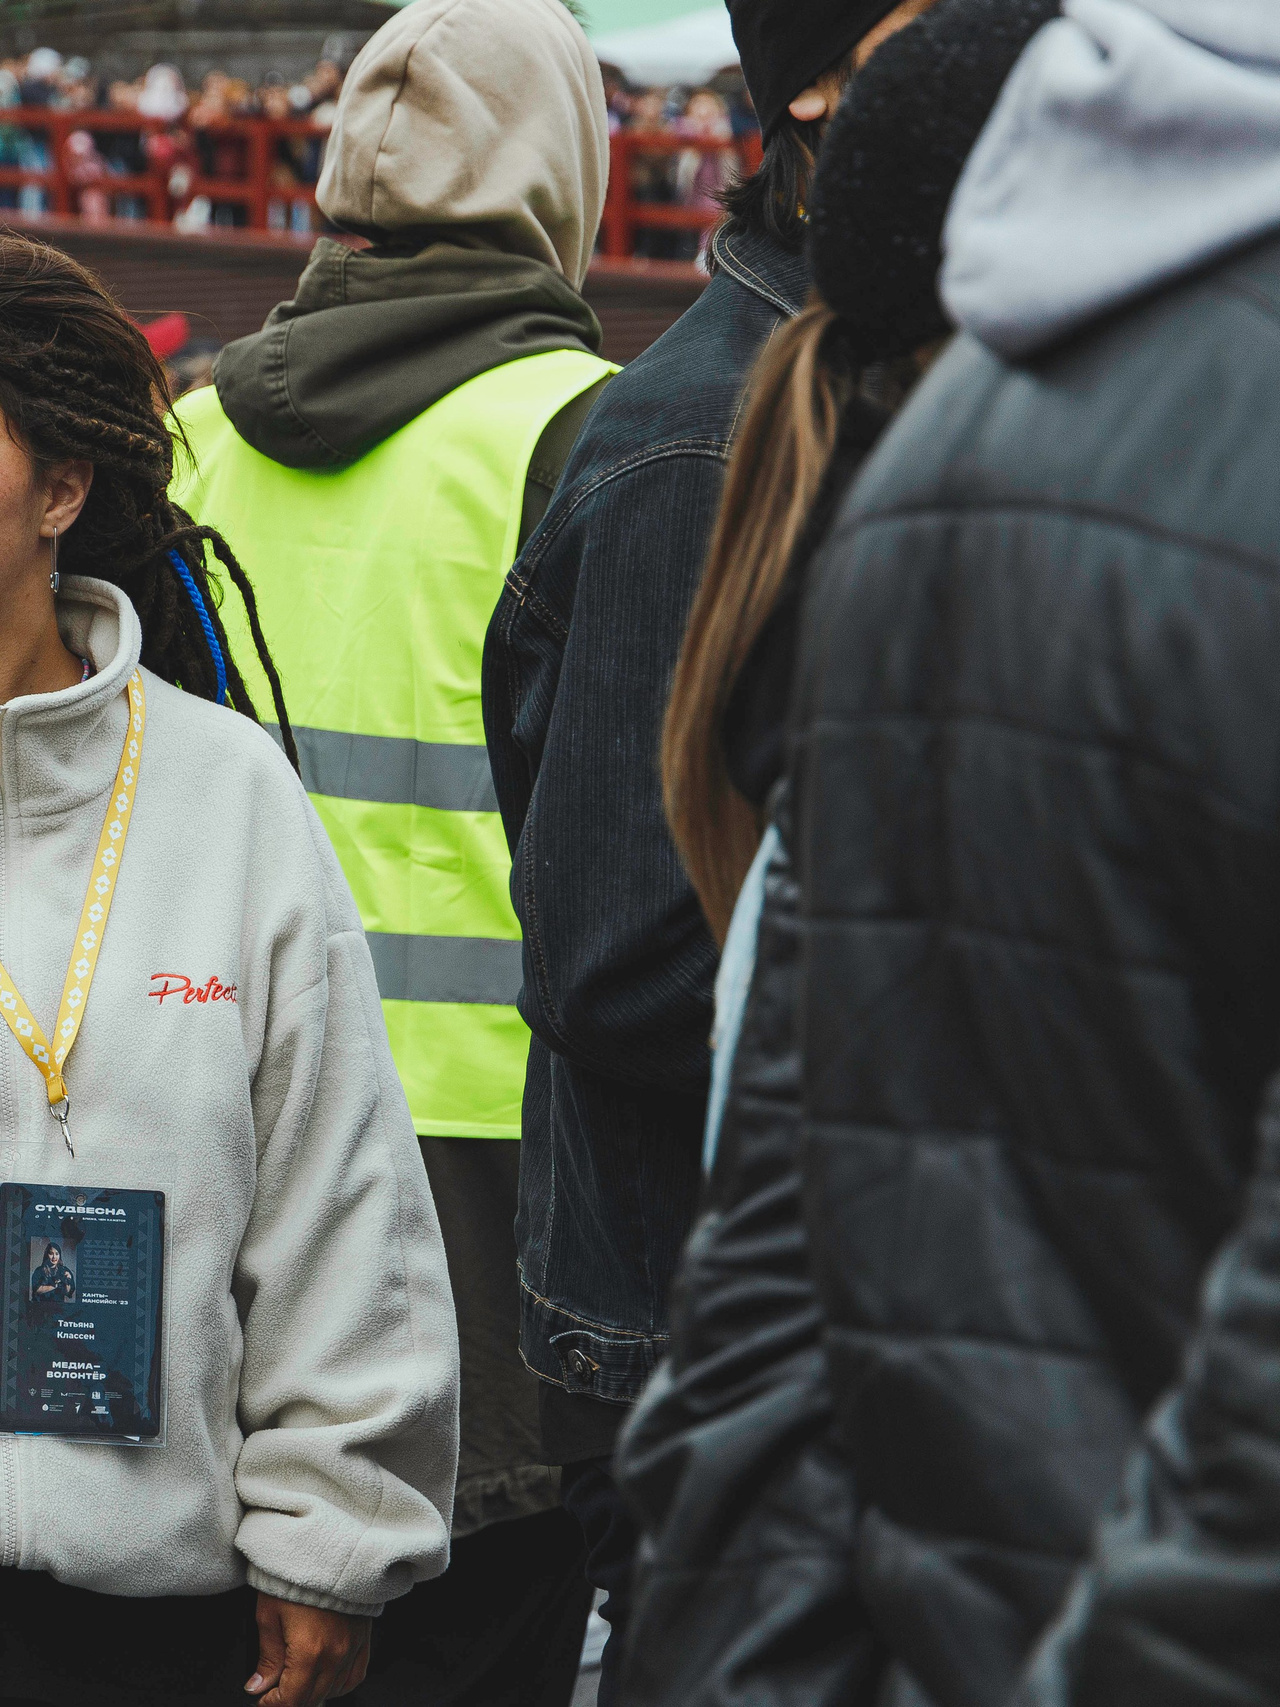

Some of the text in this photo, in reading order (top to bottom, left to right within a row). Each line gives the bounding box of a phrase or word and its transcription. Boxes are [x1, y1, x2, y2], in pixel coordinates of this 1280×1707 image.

[148, 973, 238, 1005] Perfect
[34, 1204, 127, 1216] СТУДВЕСНА
[58, 1319, 95, 1329] Татьяна
[56, 1331, 95, 1340] Классен
[46, 1370, 107, 1381] ВОЛОНТЁР
